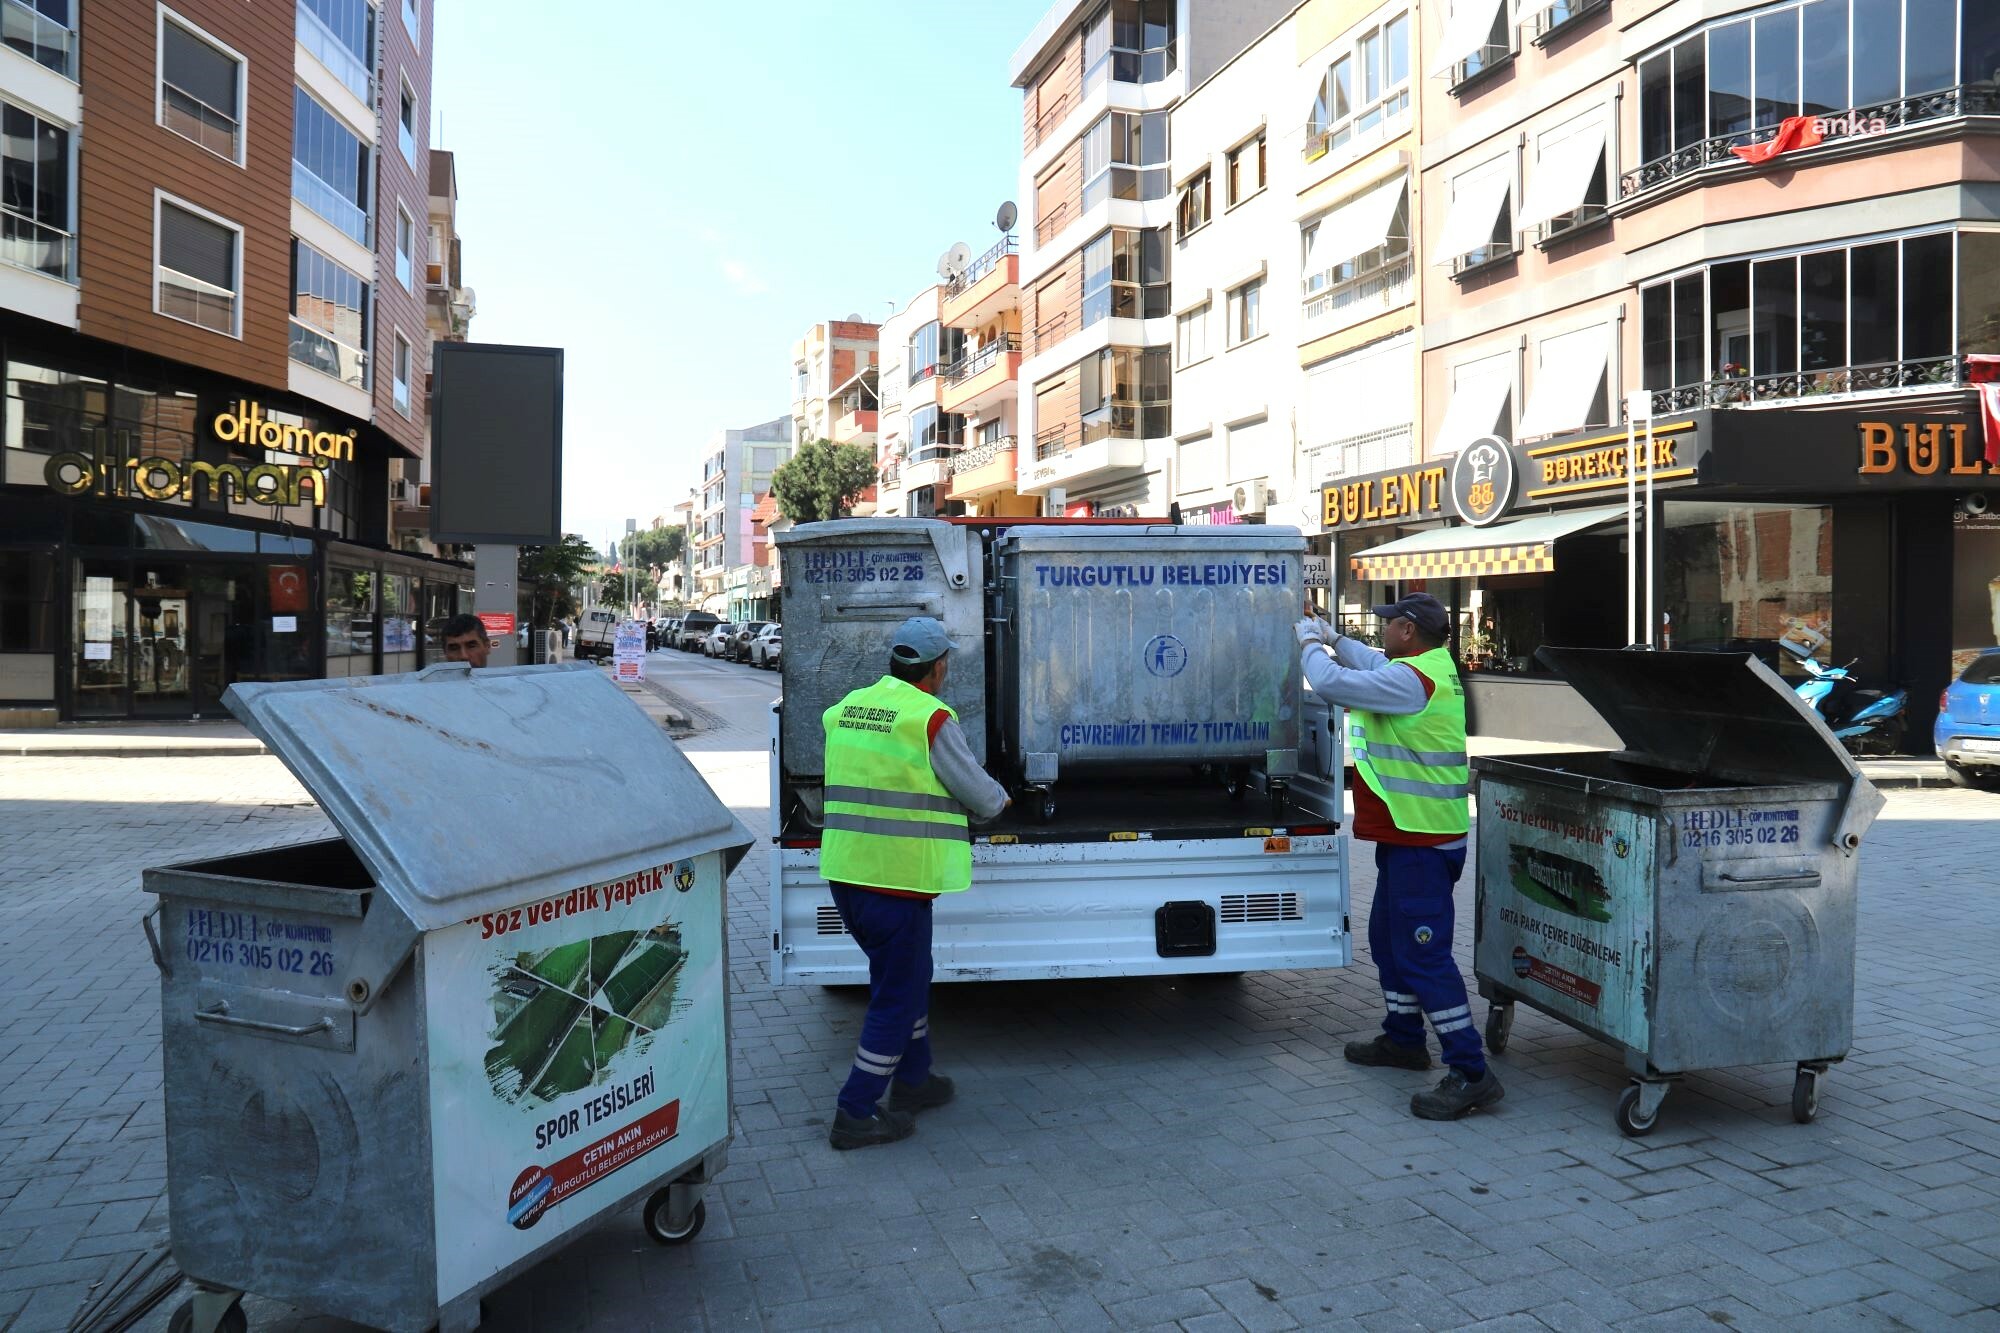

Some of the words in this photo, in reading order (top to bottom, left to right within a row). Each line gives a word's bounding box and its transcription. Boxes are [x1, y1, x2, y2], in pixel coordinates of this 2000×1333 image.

[214, 399, 353, 461] ottoman
[1542, 437, 1676, 478] BÖREKÇLİK
[1324, 467, 1444, 525] BÜLENT
[804, 568, 842, 584] 0216
[848, 567, 875, 582] 305
[880, 567, 899, 581] 02
[904, 565, 924, 581] 26
[1036, 565, 1154, 587] TURGUTLU
[1163, 560, 1286, 586] BELEDİYESİ
[1061, 720, 1146, 749] ÇEVREMİZİ
[1151, 719, 1198, 745] TEMİZ
[1203, 721, 1270, 743] TUTALIM
[1683, 830, 1721, 848] 0216
[1726, 828, 1754, 845] 305
[1758, 827, 1777, 843] 02
[1780, 825, 1799, 843] 26
[527, 885, 599, 926] verdik
[187, 939, 234, 964] 0216
[240, 943, 272, 970] 305
[278, 947, 304, 974] 02
[309, 950, 334, 976] 26
[1500, 907, 1519, 926] ORTA
[1520, 913, 1541, 935] PARK
[1543, 923, 1568, 946] ÇEVRE
[1571, 931, 1622, 968] DÜZENLEME
[536, 1109, 579, 1150] SPOR
[584, 1066, 655, 1127] TESİSLERİ
[552, 1166, 598, 1197] TURGUTLU
[598, 1145, 635, 1173] BELEDİYE
[636, 1126, 669, 1151] BAŞKANI
[583, 1141, 615, 1167] ÇETİN
[617, 1125, 642, 1148] AKIN
[512, 1169, 541, 1200] TAMAMI
